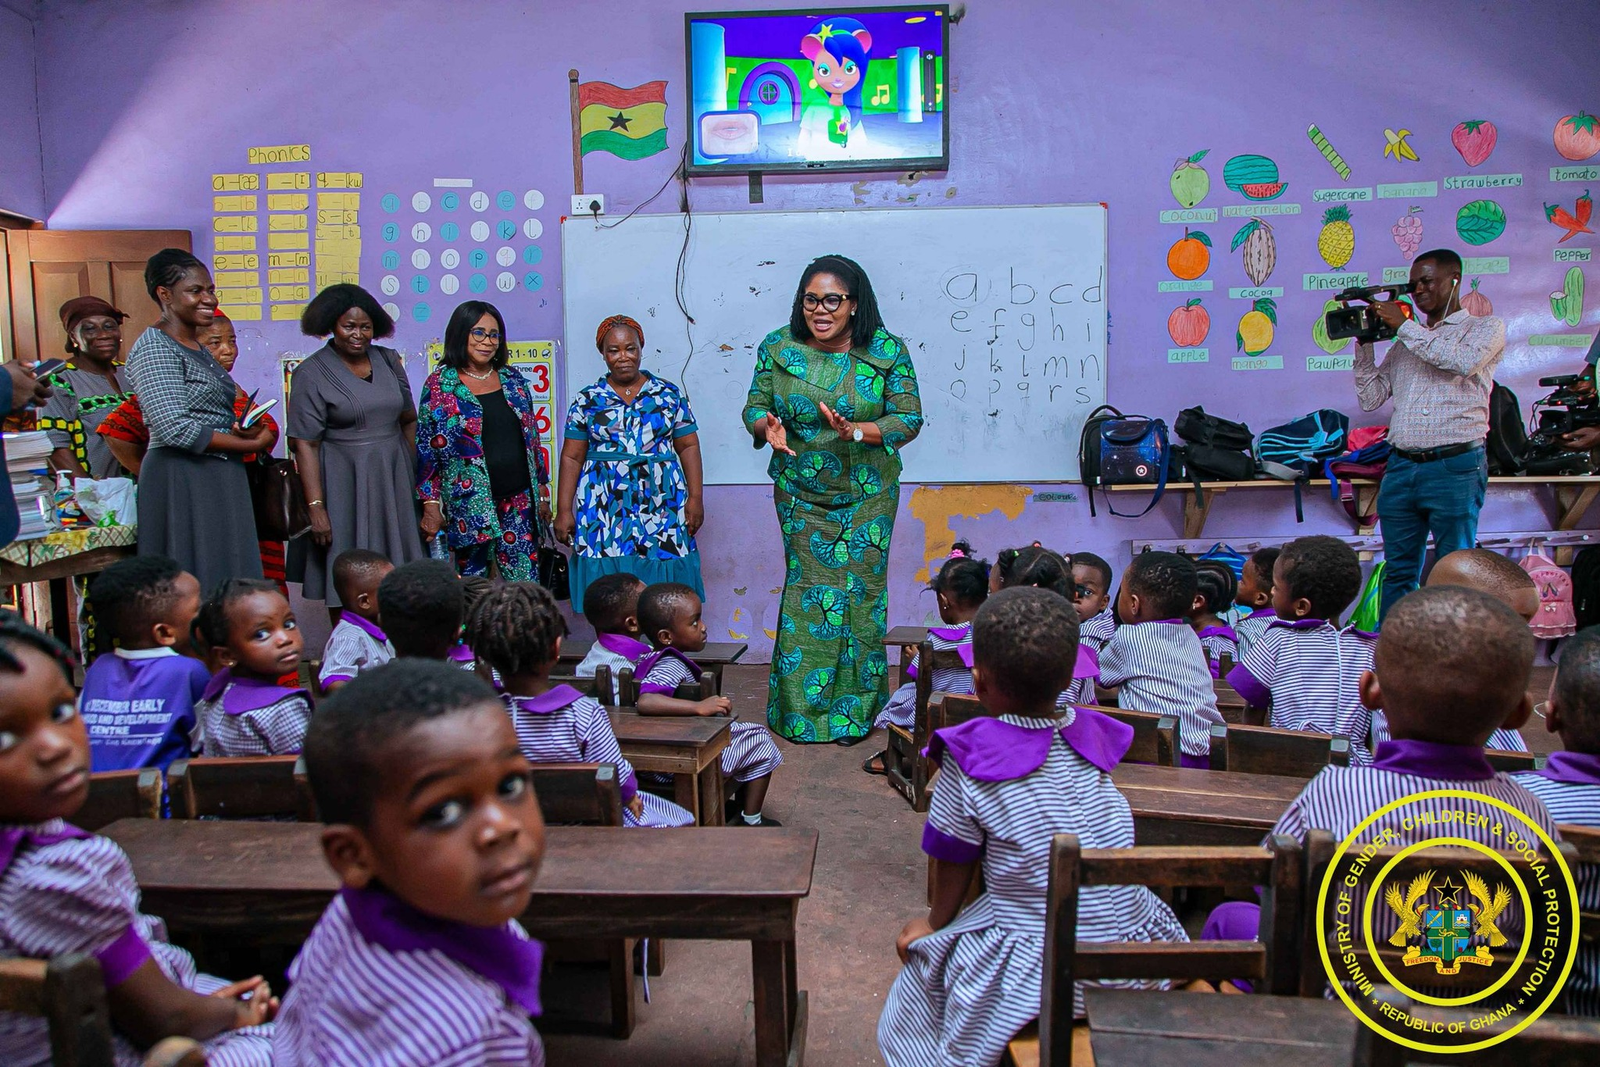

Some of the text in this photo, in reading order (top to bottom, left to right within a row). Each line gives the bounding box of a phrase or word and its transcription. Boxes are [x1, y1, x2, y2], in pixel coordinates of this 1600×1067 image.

[946, 273, 978, 302] a
[1010, 266, 1036, 304] b
[1082, 265, 1102, 302] d
[950, 310, 972, 332] e
[988, 308, 1006, 340] f
[1017, 313, 1036, 351] g
[1050, 307, 1064, 342] h
[528, 349, 538, 358] 10
[990, 348, 1002, 372] k
[1022, 354, 1029, 378] l
[1044, 356, 1068, 378] m
[1080, 354, 1100, 381] n
[533, 364, 550, 394] 3
[988, 379, 1002, 407] p
[1049, 384, 1062, 402] r
[536, 406, 552, 434] 6
[131, 699, 166, 713] EARLY
